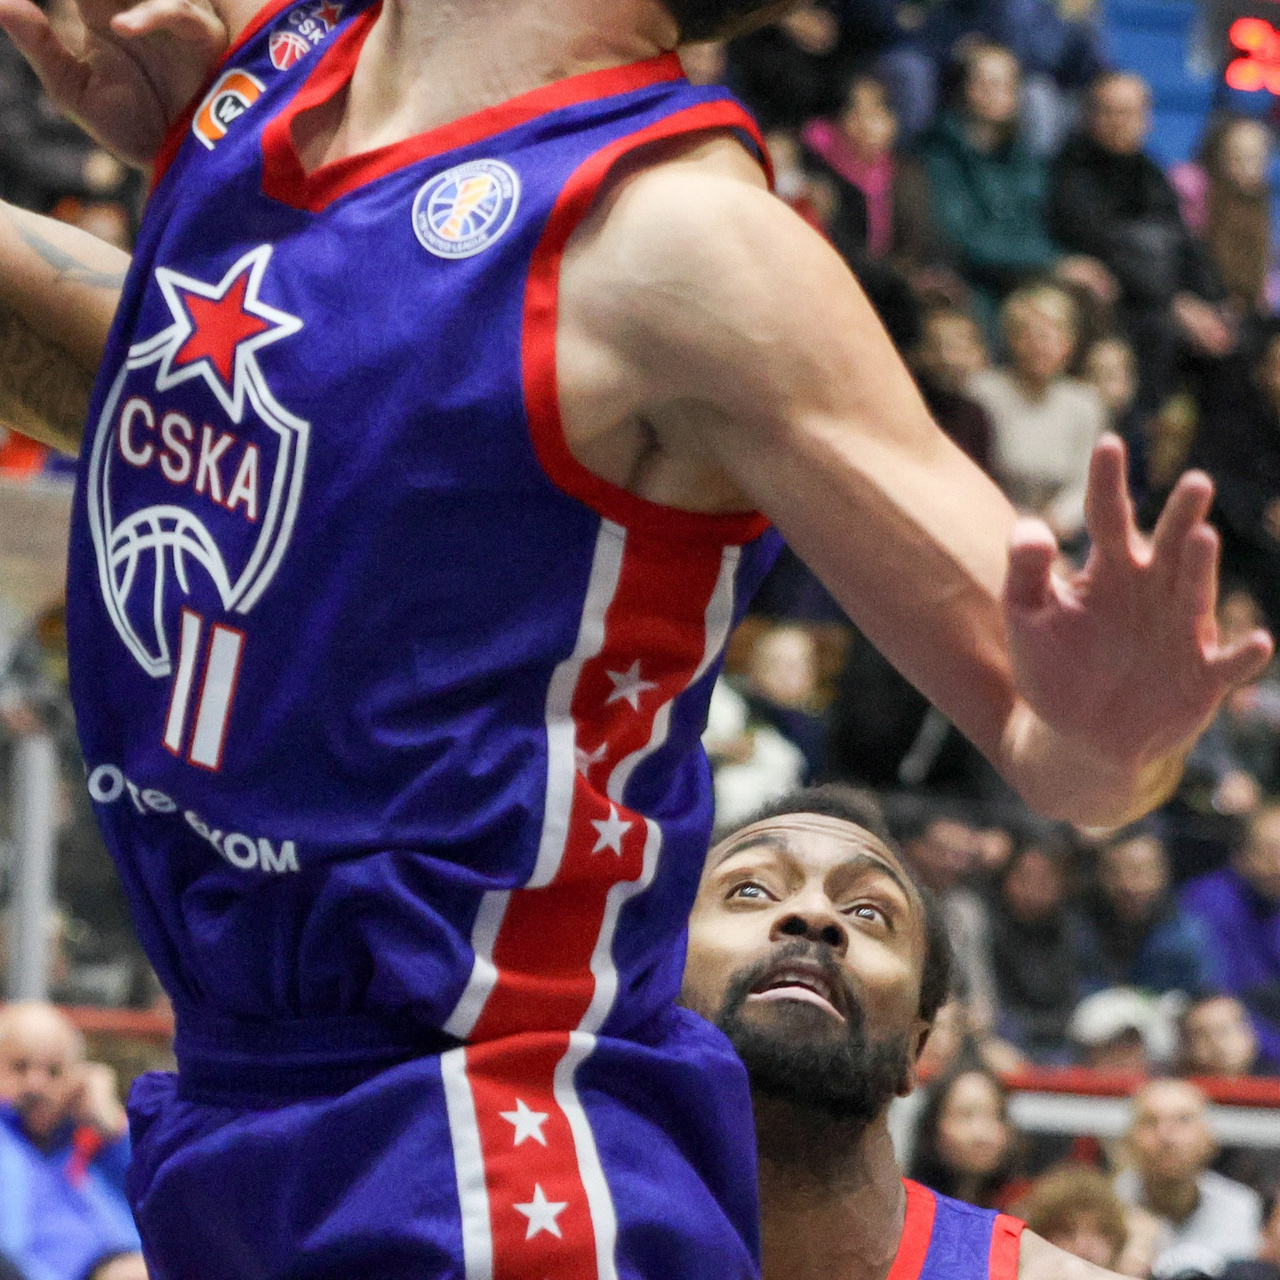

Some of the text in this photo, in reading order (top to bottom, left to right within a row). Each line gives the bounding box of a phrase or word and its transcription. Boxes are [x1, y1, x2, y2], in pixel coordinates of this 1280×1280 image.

[289, 10, 325, 45] CSK
[118, 396, 260, 522] CSKA
[161, 605, 246, 772] 11
